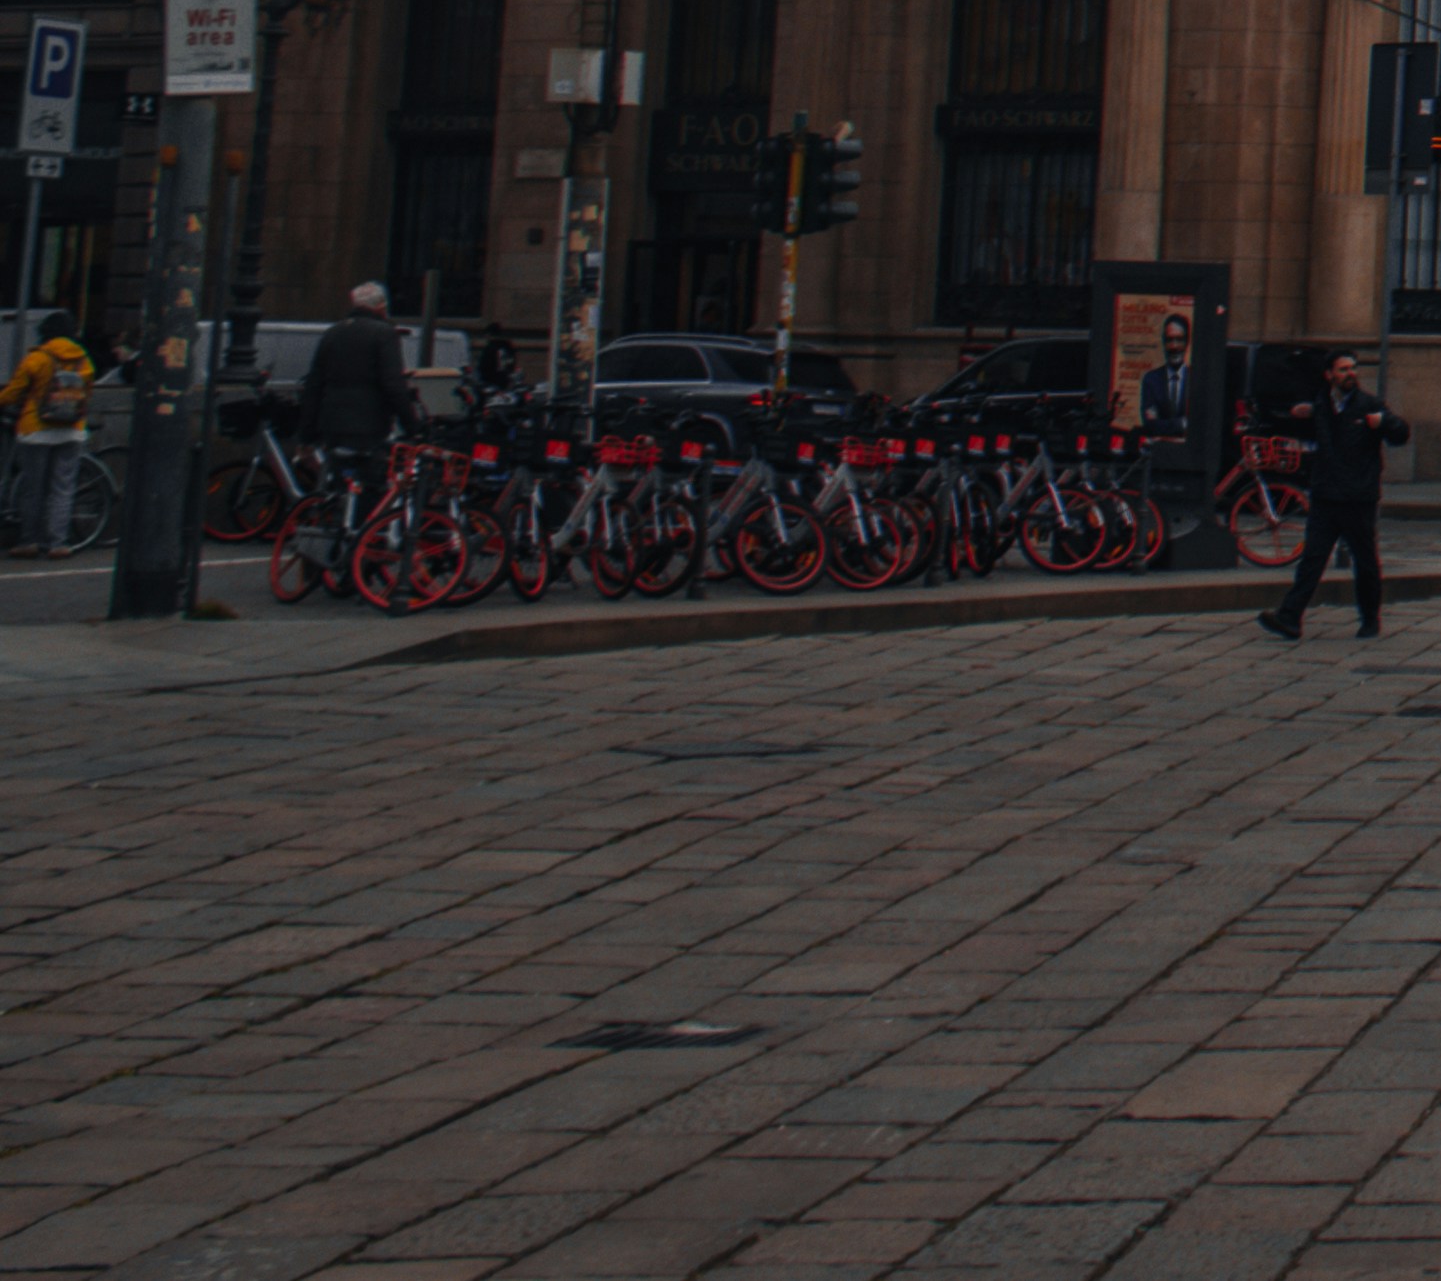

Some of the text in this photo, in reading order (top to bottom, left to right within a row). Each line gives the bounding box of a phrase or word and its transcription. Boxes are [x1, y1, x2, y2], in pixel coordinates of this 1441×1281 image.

[186, 8, 236, 27] Wi-Fi
[186, 31, 235, 46] area
[40, 35, 70, 89] P
